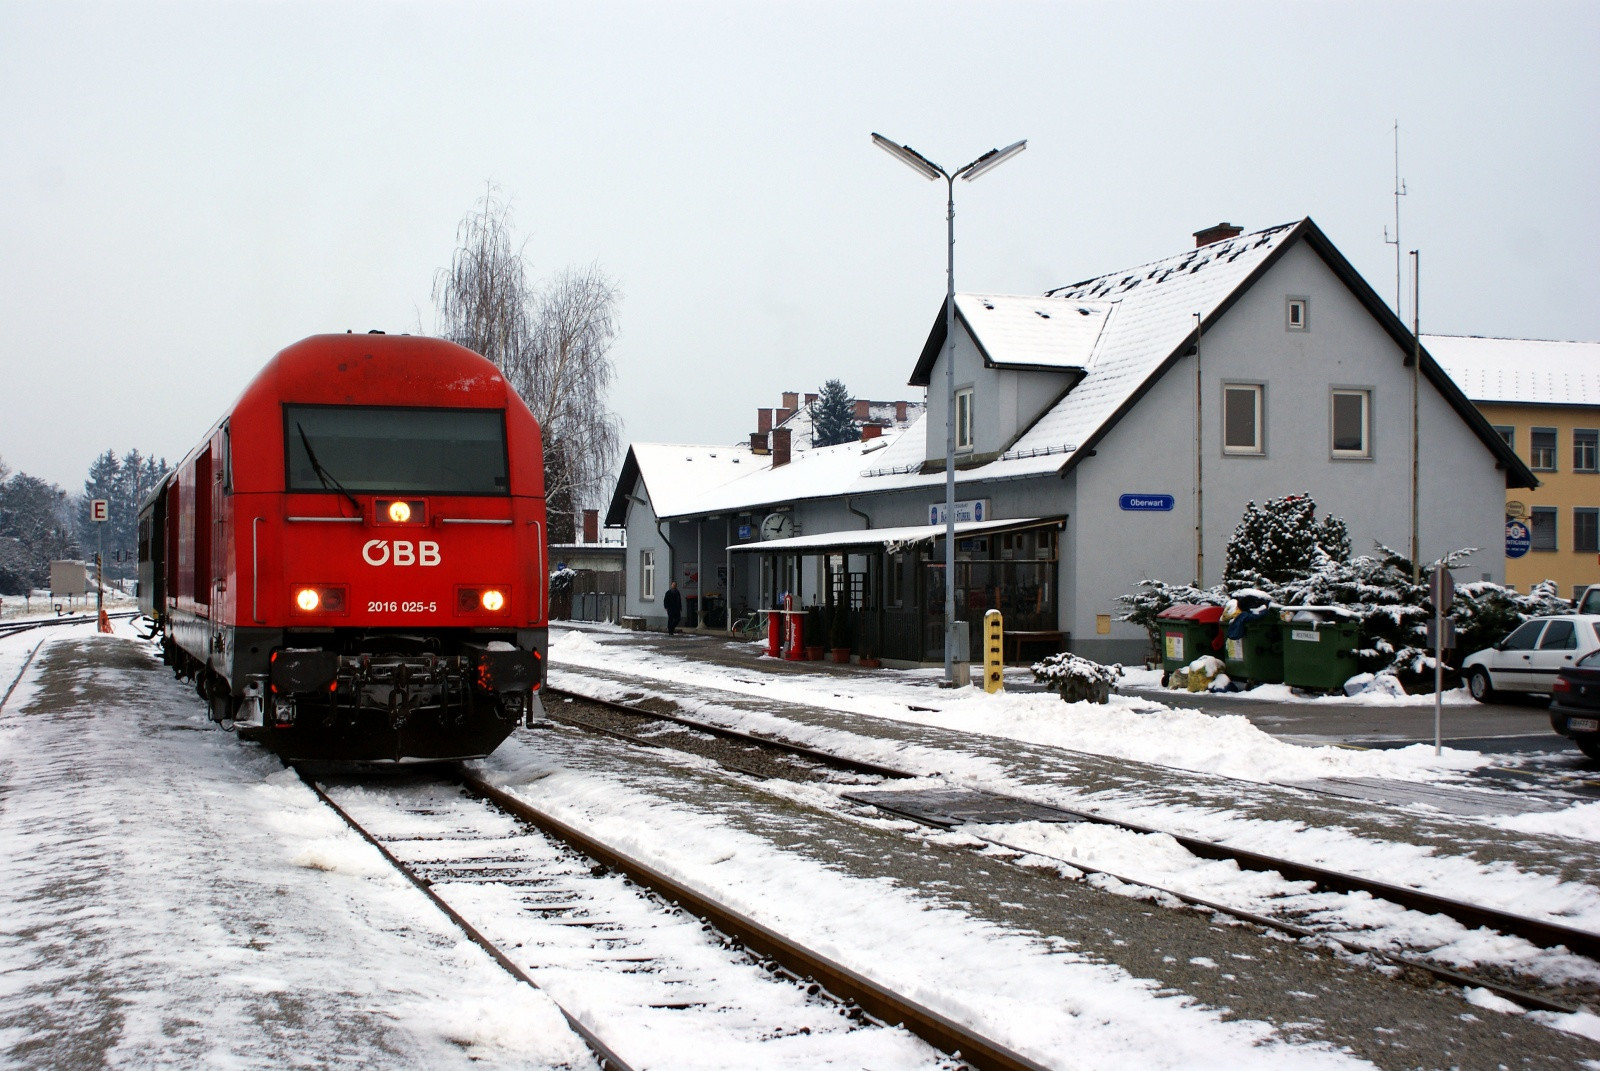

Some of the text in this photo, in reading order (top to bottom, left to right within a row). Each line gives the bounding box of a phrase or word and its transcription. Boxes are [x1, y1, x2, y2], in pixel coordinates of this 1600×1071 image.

[95, 502, 105, 518] E
[1130, 499, 1164, 507] Oberwart
[362, 539, 441, 567] ÖBB
[367, 601, 437, 613] 2016 025-5
